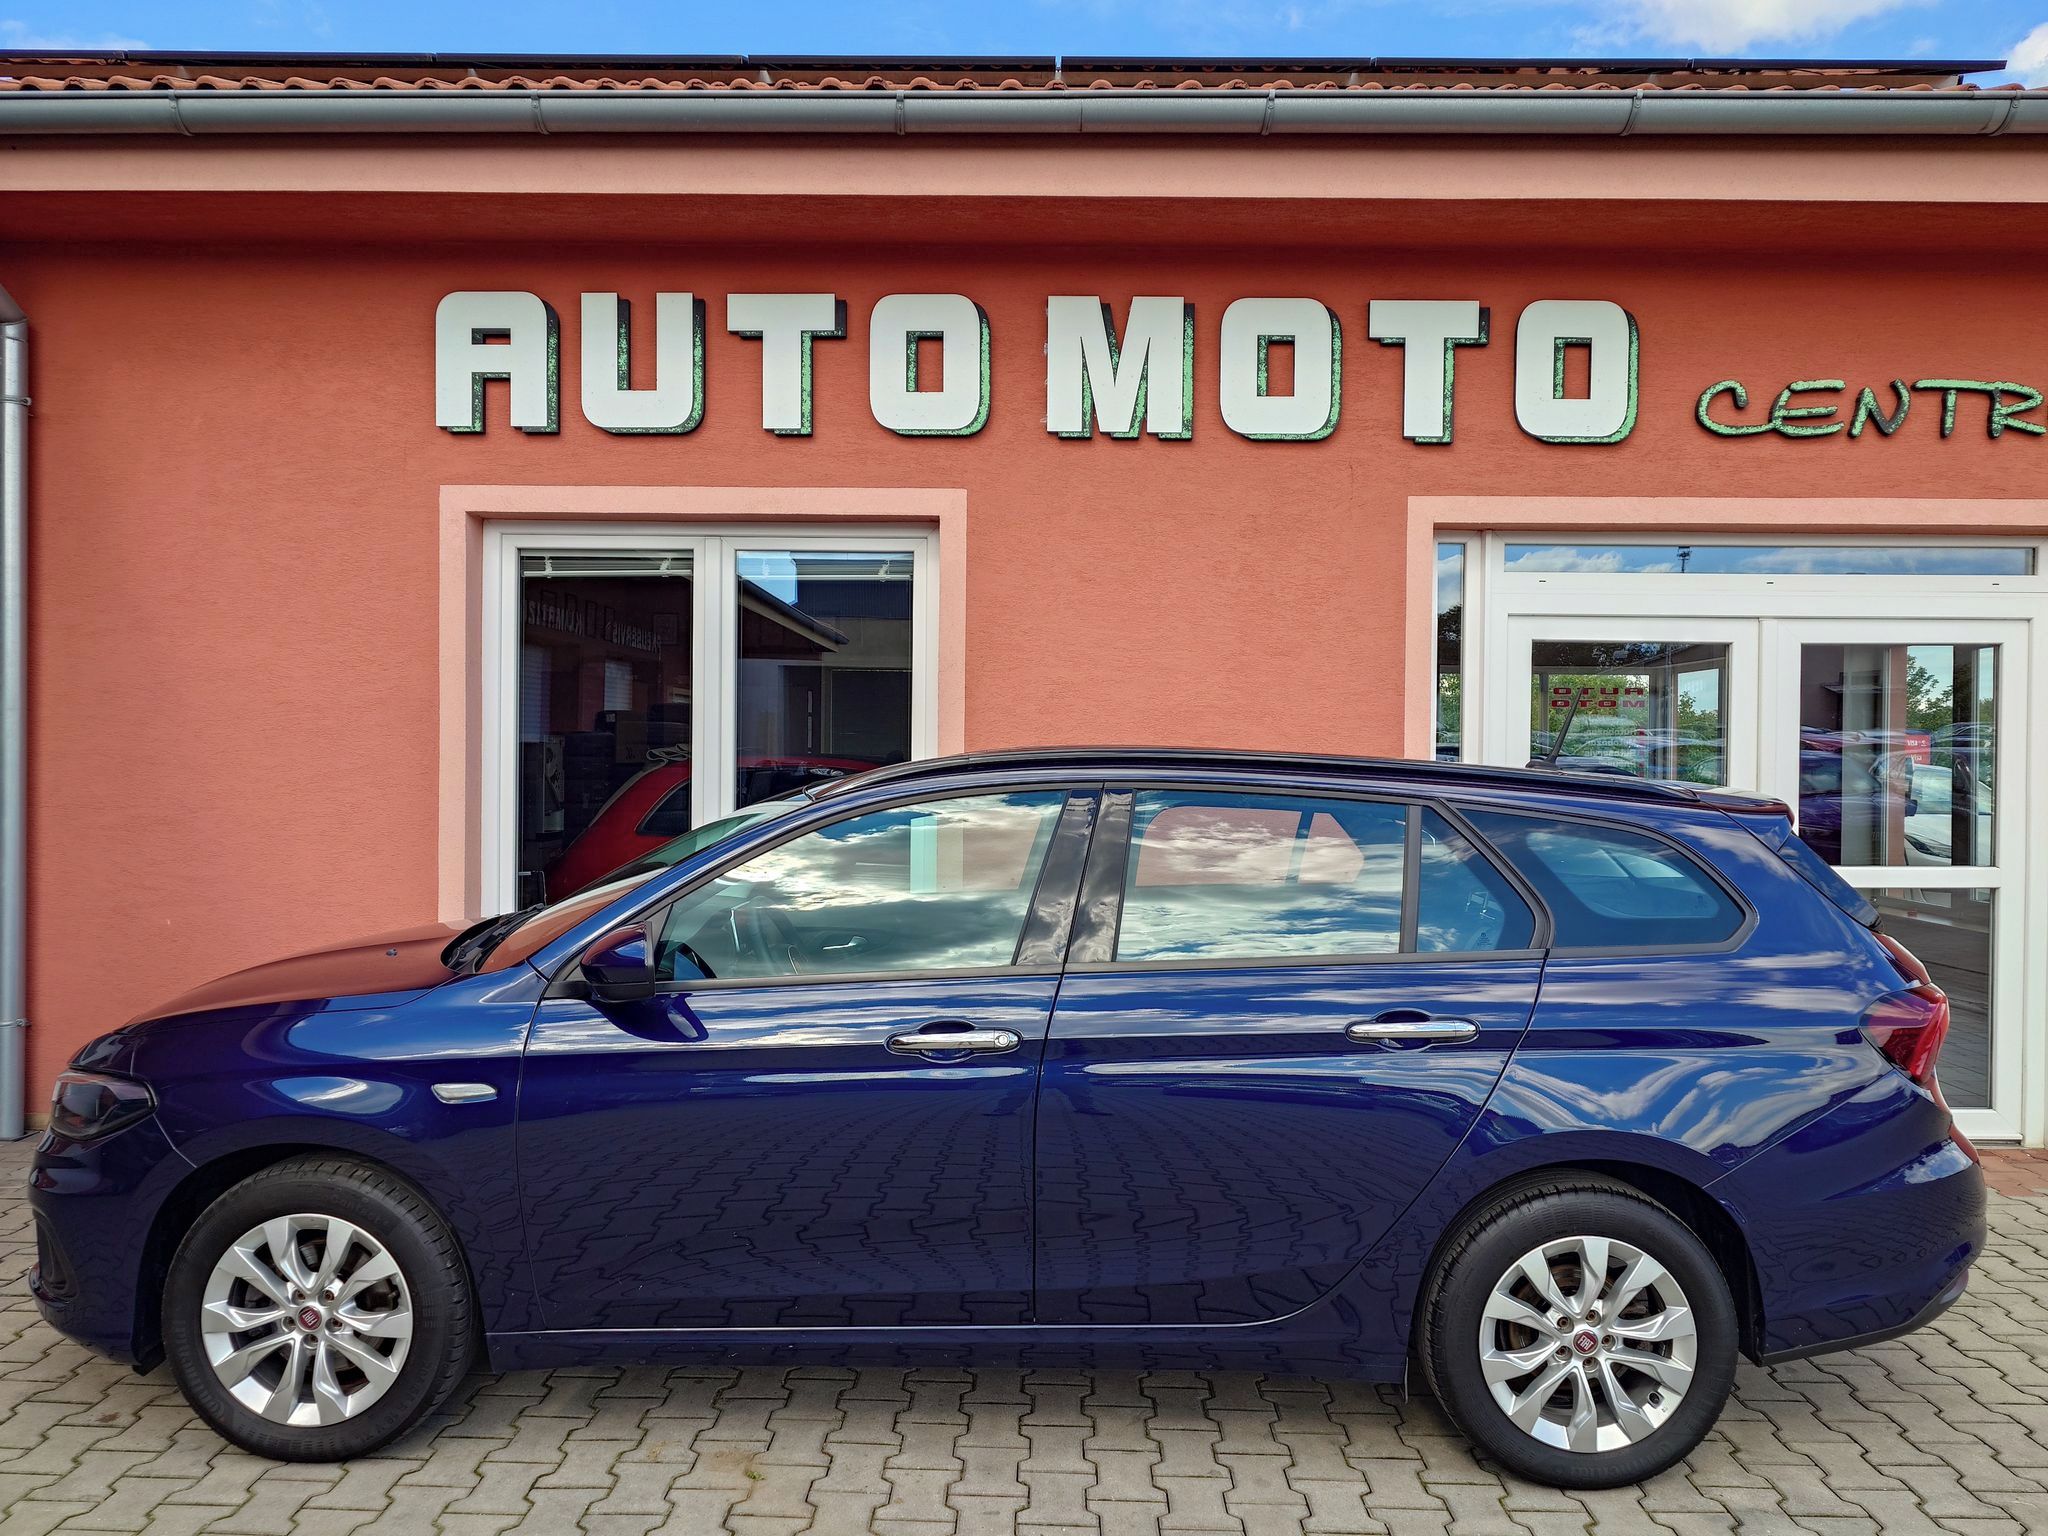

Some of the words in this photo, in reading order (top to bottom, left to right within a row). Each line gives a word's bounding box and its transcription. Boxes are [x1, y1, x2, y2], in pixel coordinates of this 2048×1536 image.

[435, 290, 991, 436] AUTO
[1046, 294, 1640, 446] MOTO
[1697, 378, 2048, 439] CENTR
[302, 1310, 317, 1326] FIAT
[1577, 1334, 1595, 1351] FIAT
